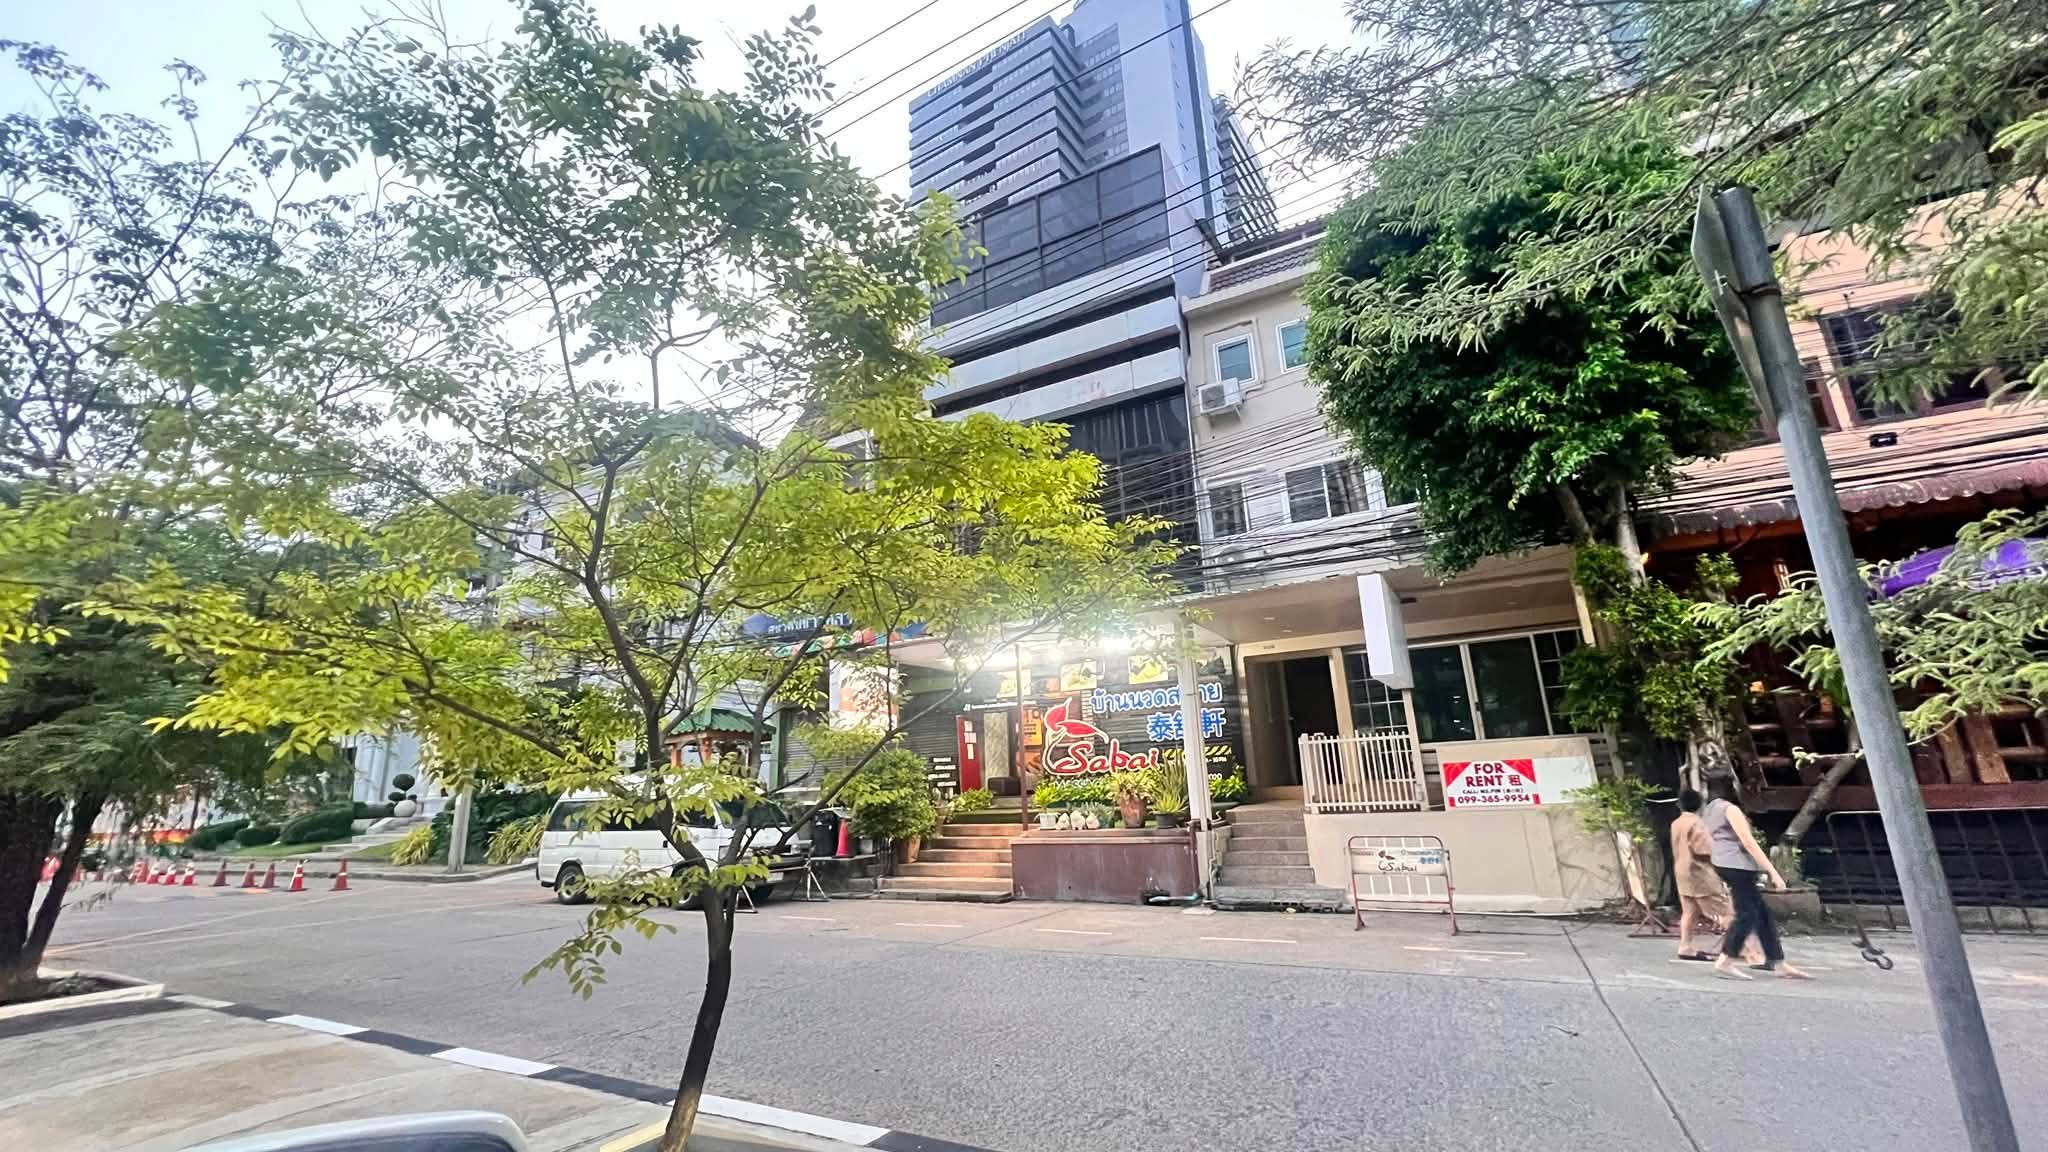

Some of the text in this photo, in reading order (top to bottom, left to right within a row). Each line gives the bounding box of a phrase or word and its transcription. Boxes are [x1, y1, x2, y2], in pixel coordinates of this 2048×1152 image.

[1090, 682, 1222, 713] บ้านนวดสาย
[1053, 738, 1160, 775] Sabai
[1474, 762, 1505, 774] FOR
[1465, 775, 1503, 787] RENT
